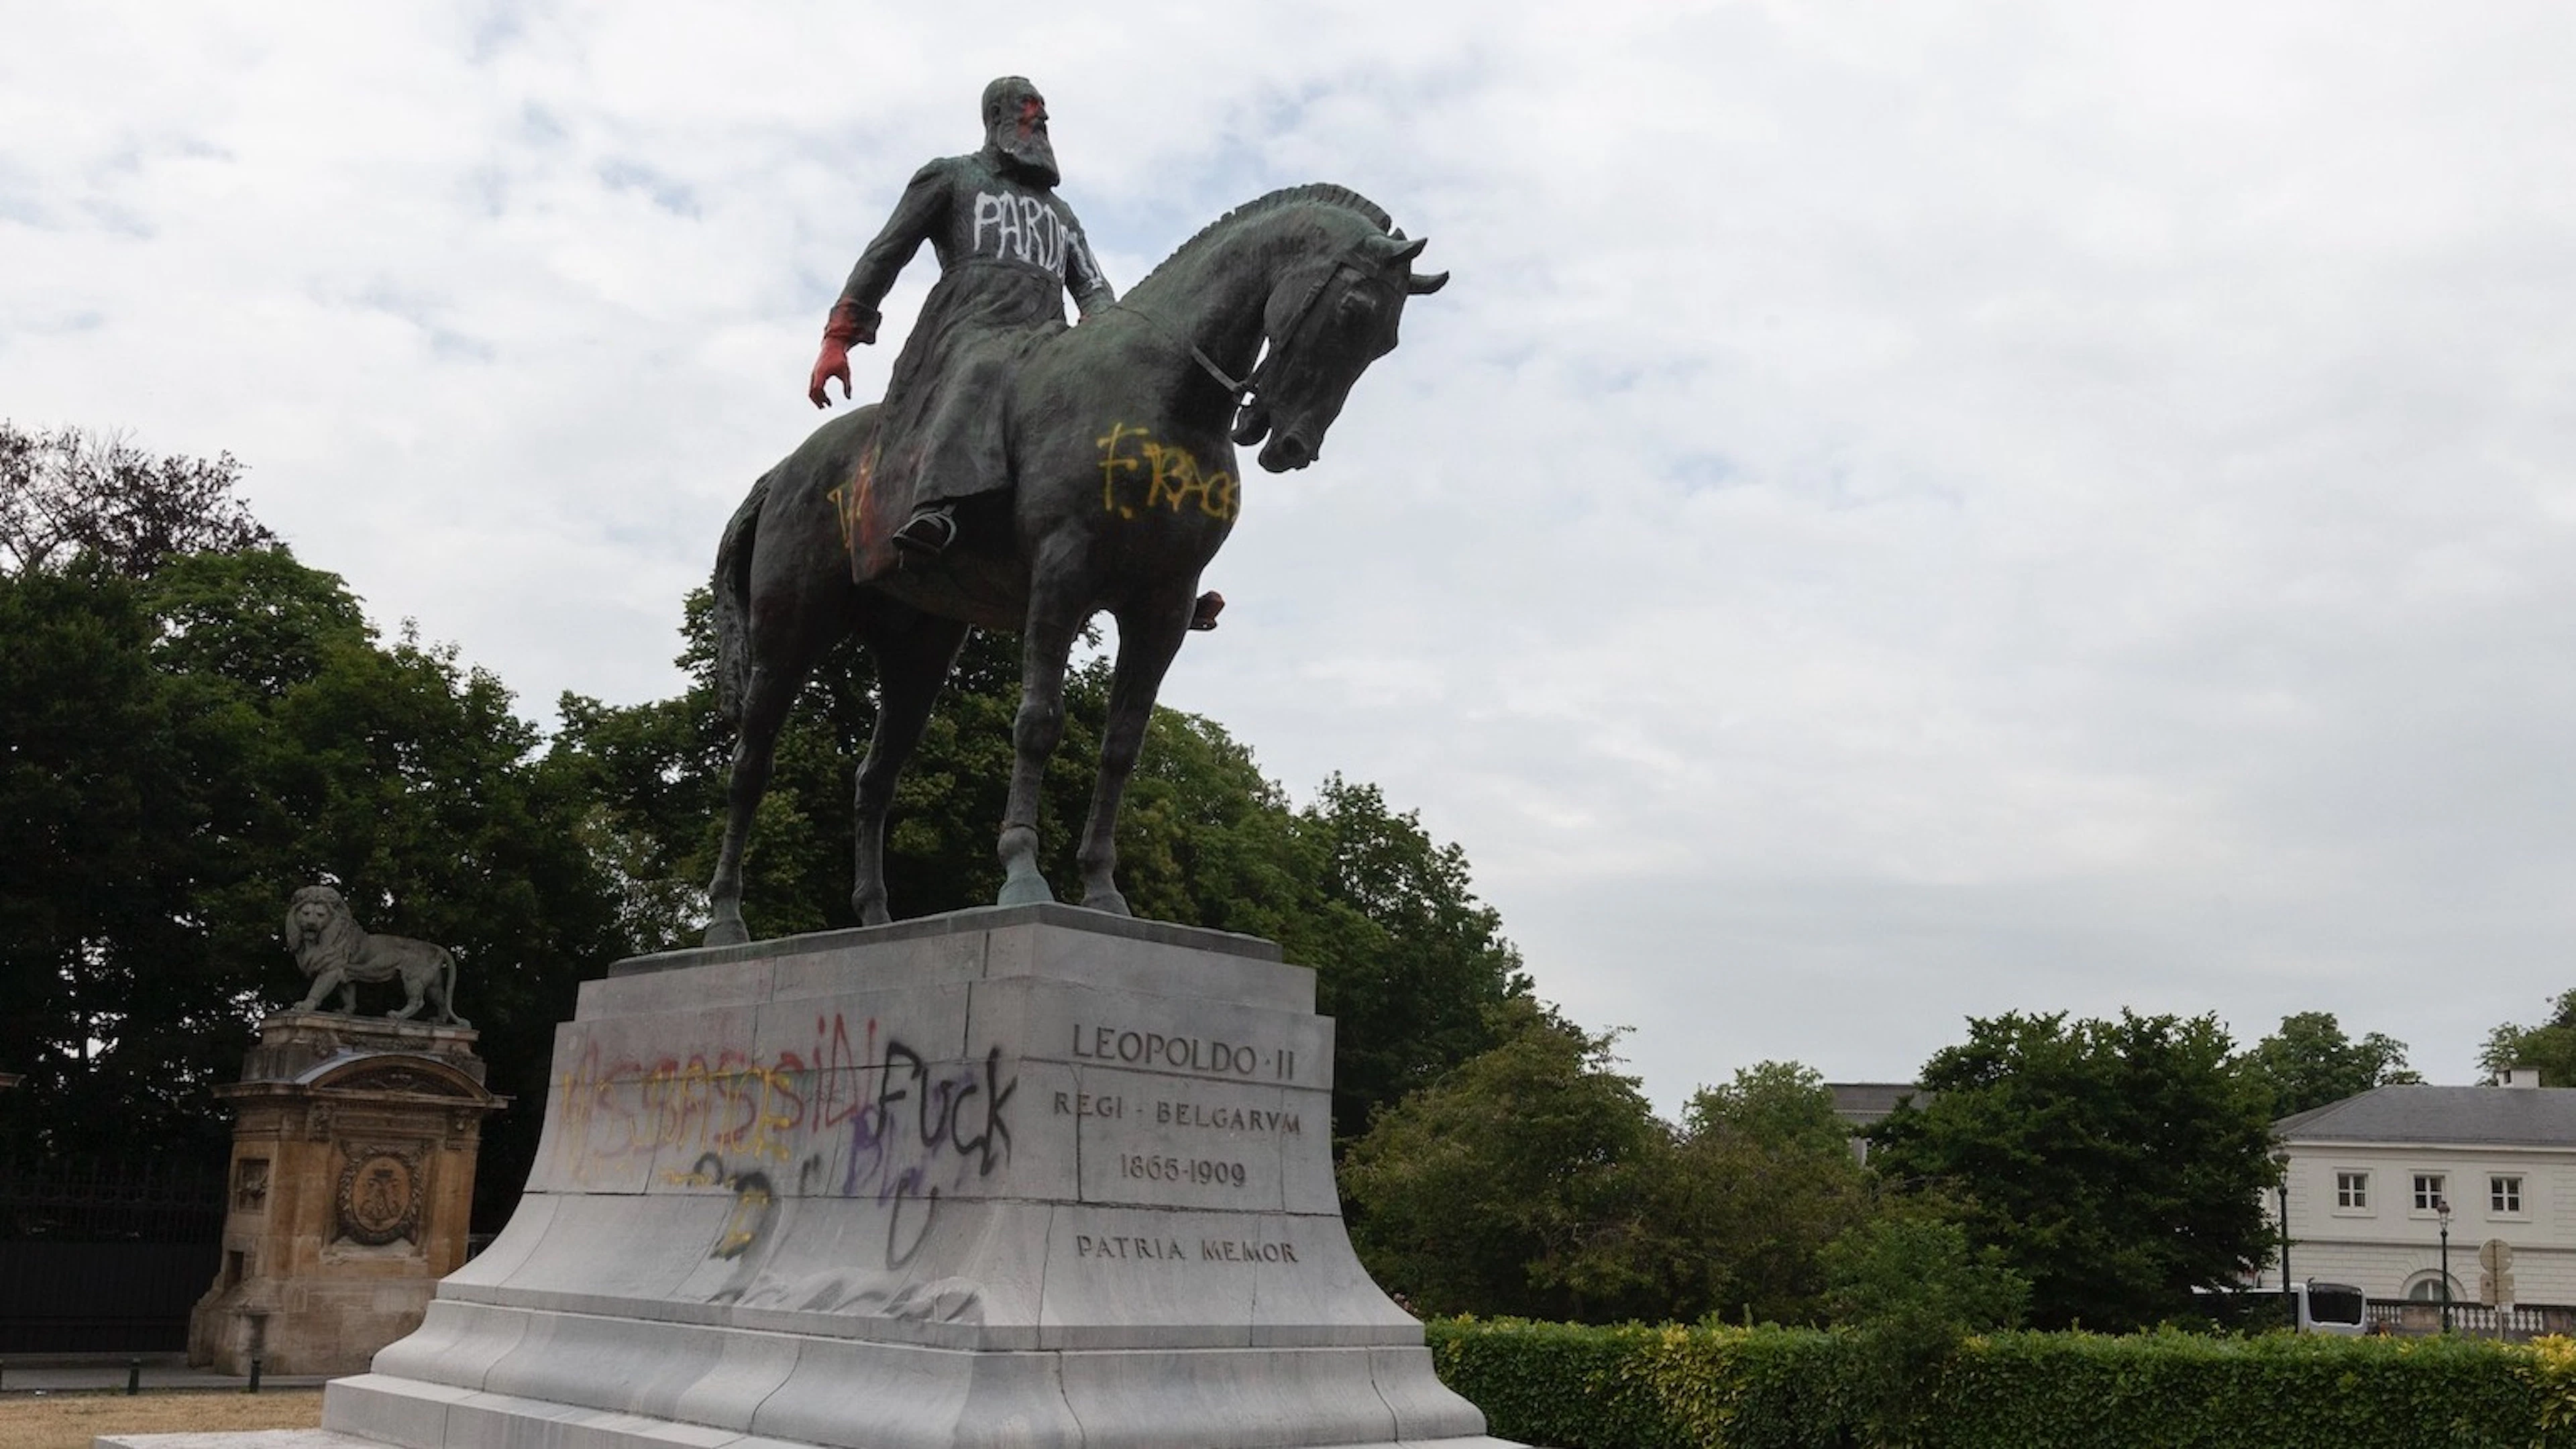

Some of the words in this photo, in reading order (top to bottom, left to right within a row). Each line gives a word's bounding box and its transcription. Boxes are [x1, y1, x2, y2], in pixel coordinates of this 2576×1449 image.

[1073, 1024, 1256, 1075] LEOPOLDO
[1053, 1091, 1123, 1119] REGI
[1157, 1101, 1301, 1135] BELGARVM
[1120, 1153, 1247, 1187] 1865-1909
[1076, 1234, 1185, 1261] PATRIA
[1201, 1239, 1299, 1264] MEMOR
